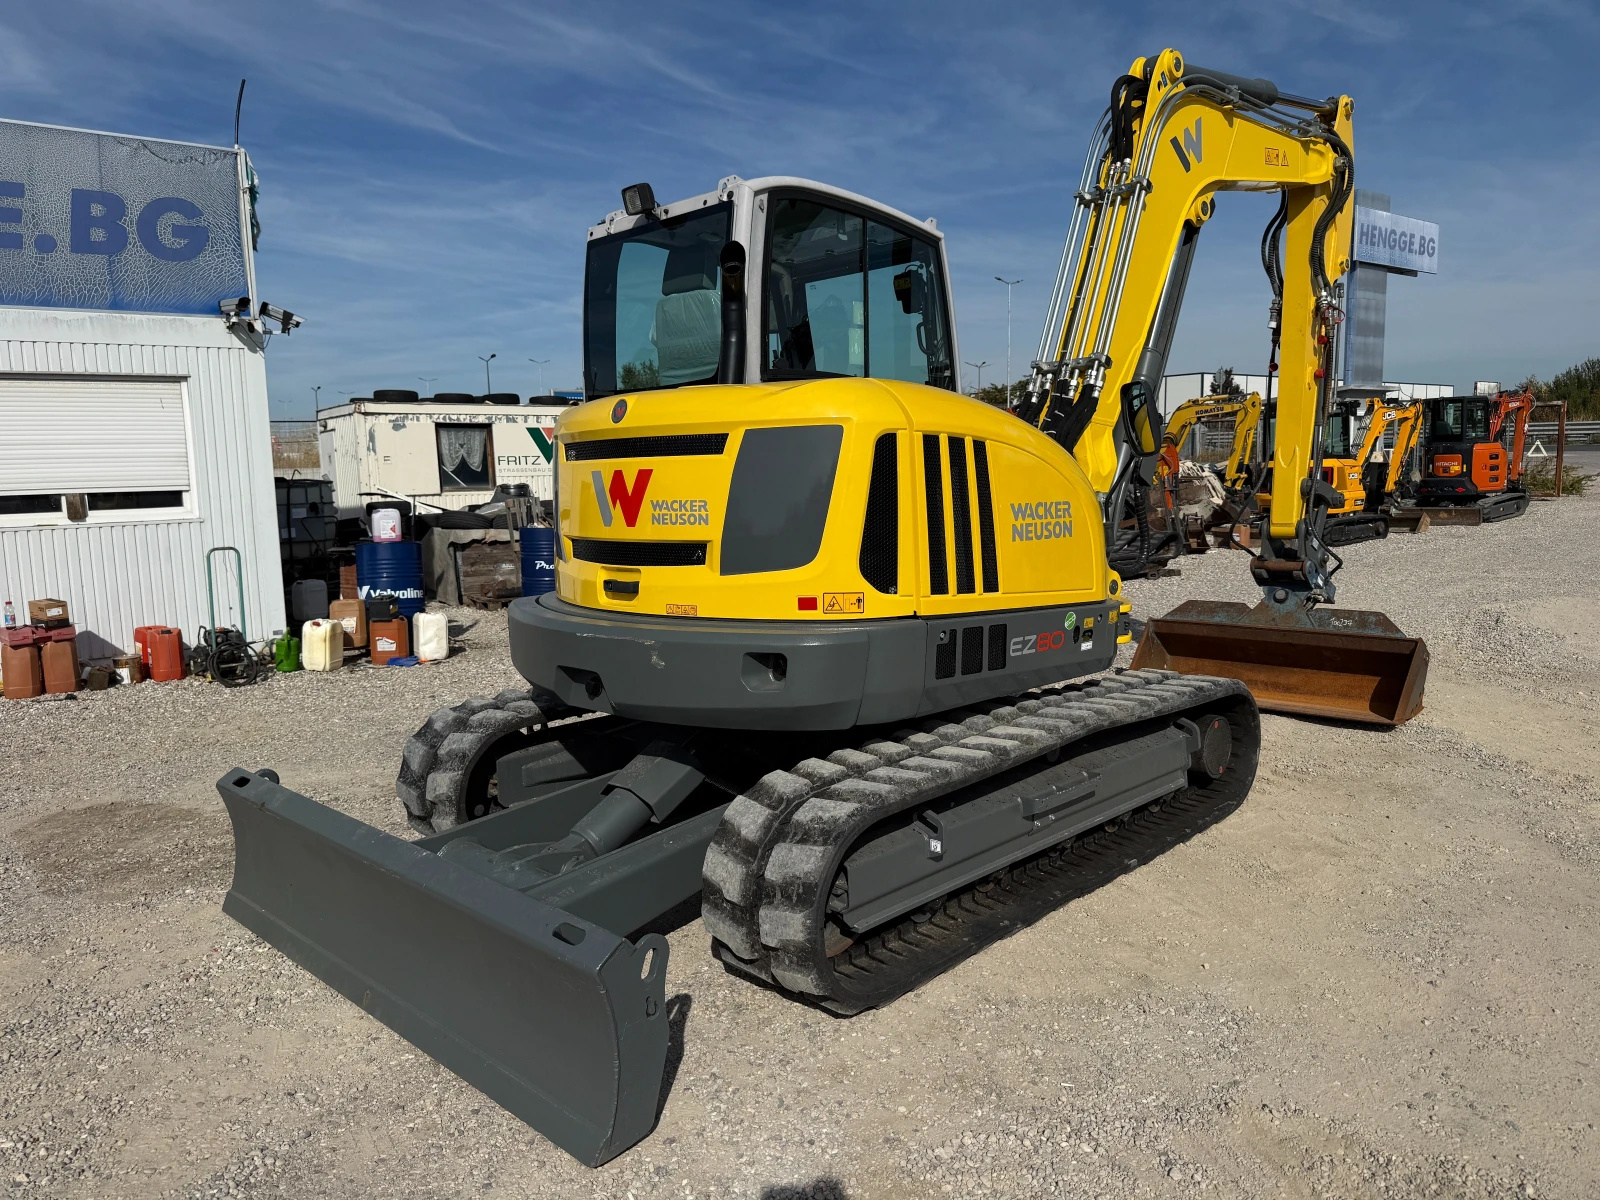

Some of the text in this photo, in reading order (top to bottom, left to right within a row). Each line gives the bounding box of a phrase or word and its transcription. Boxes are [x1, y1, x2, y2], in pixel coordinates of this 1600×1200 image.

[1360, 222, 1436, 258] HENGGE.BG
[1195, 406, 1225, 416] KOMATSU
[1382, 410, 1396, 420] JCB
[497, 455, 541, 465] FRITZ
[650, 499, 709, 512] WACKER
[1009, 500, 1073, 522] WACKER
[651, 513, 709, 526] NEUSON
[1011, 520, 1073, 543] NEUSON
[369, 588, 424, 599] Valvoline
[1010, 630, 1065, 657] EZ80
